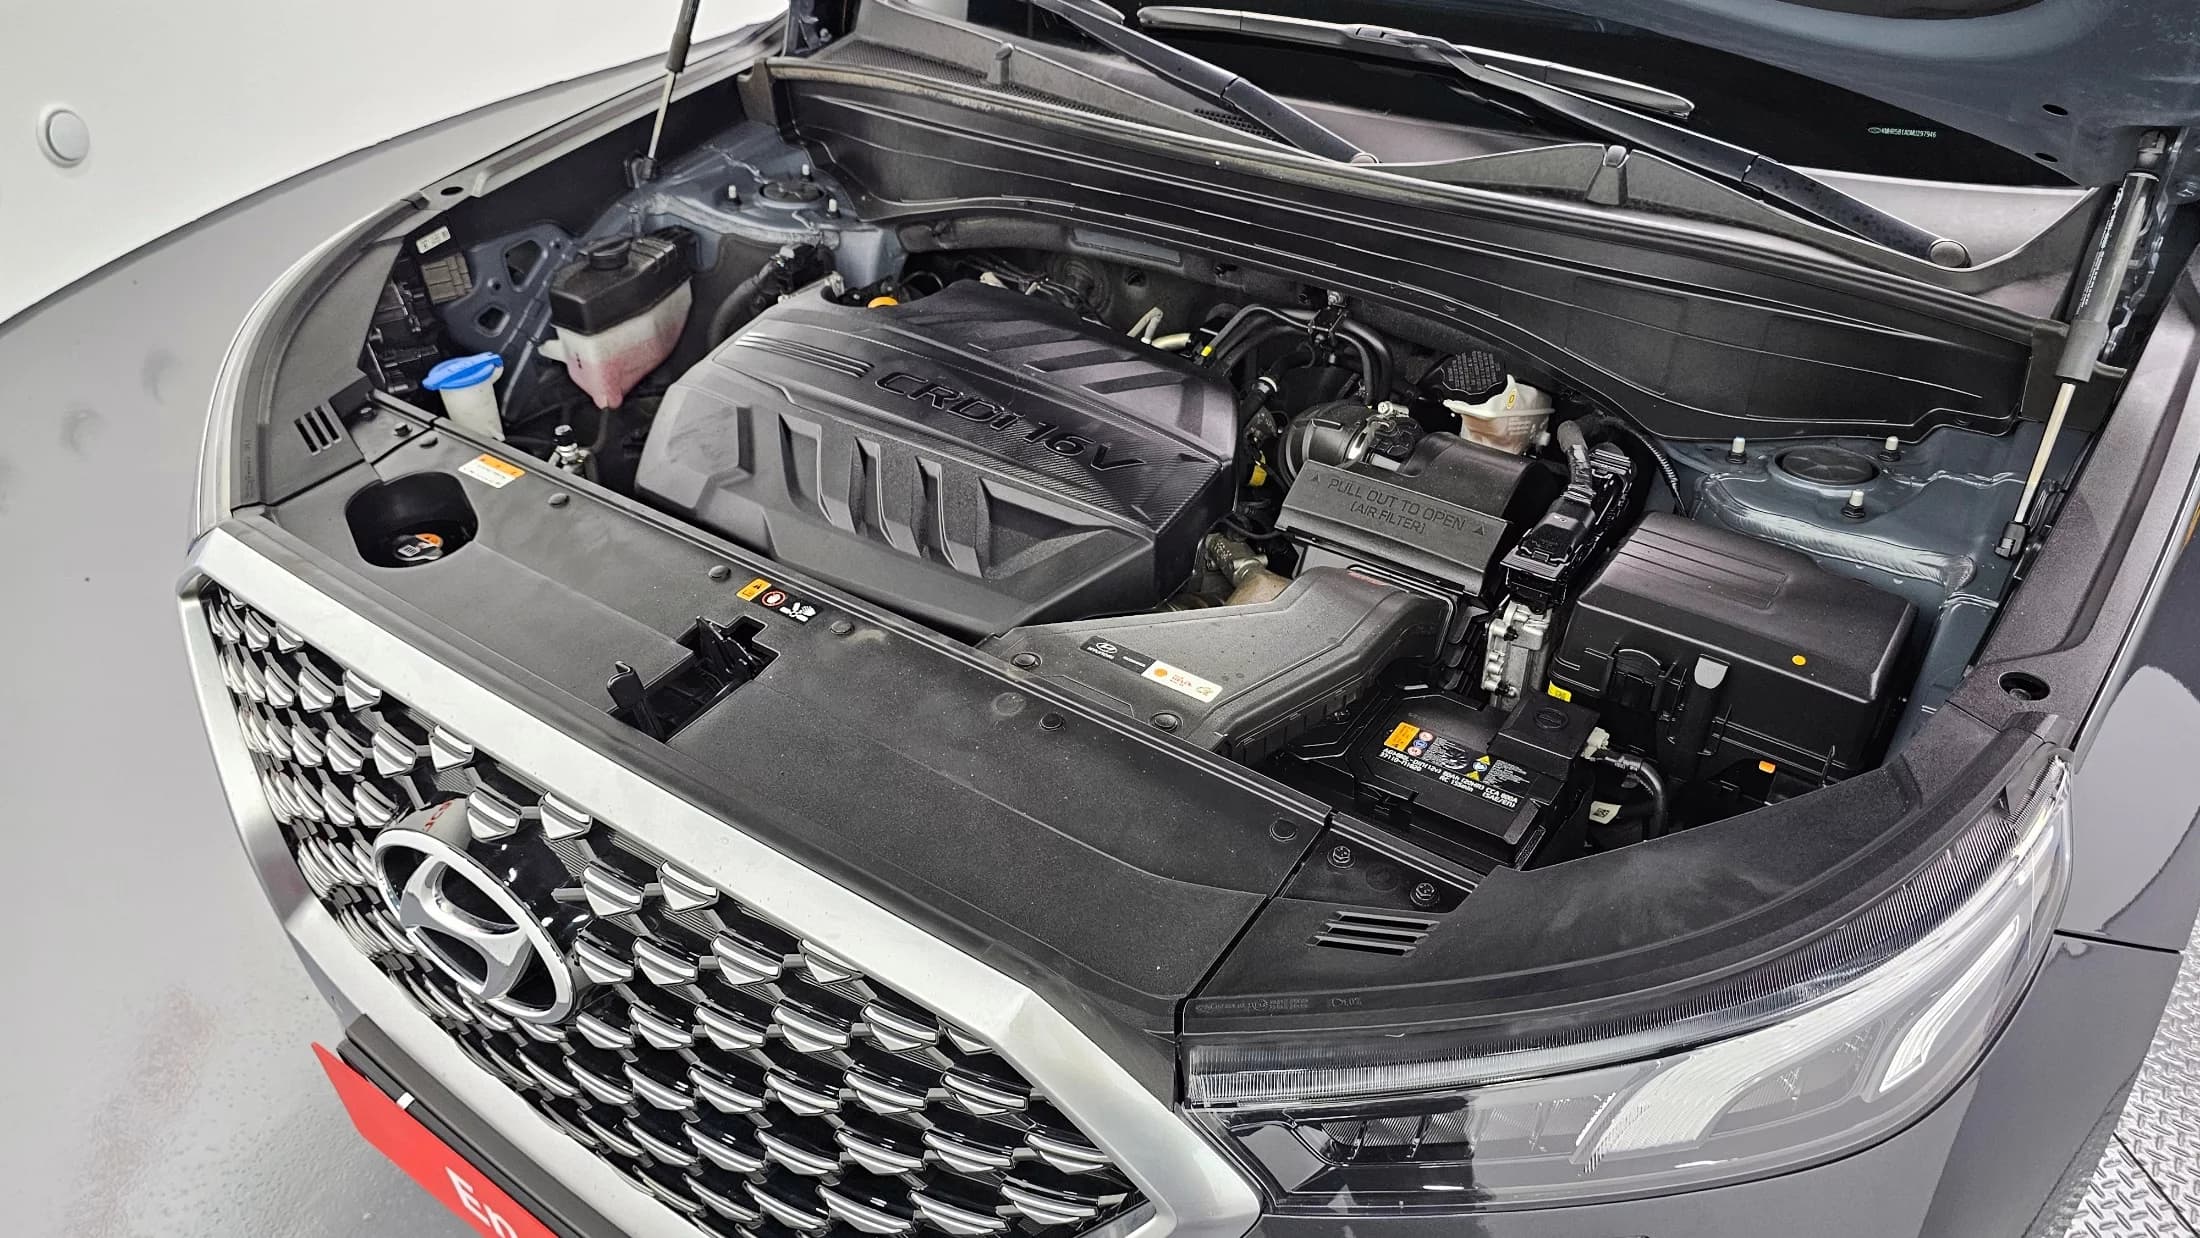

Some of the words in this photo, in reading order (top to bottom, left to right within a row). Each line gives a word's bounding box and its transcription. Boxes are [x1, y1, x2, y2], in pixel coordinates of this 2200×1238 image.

[874, 371, 1026, 431] CRDi
[1023, 420, 1147, 471] 16V
[1328, 478, 1362, 498] PULL
[1366, 489, 1399, 508] OUT
[1400, 499, 1421, 516] TO
[1423, 507, 1467, 531] OPEN
[1350, 501, 1378, 519] (AIR
[1379, 510, 1427, 534] FILTER)
